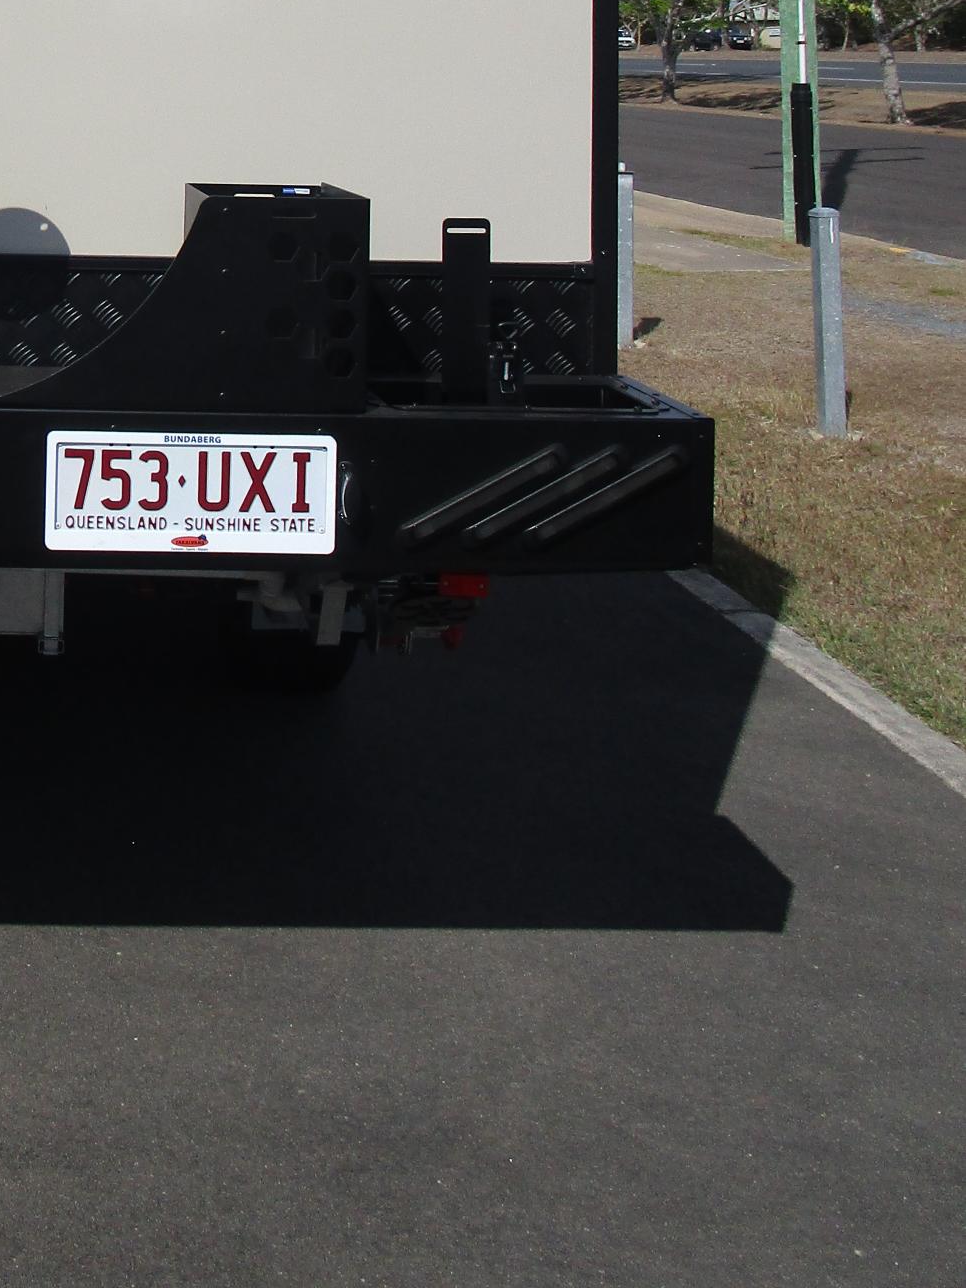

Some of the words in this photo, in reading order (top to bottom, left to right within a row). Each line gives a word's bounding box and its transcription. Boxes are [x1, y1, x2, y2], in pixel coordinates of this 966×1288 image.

[164, 435, 222, 444] BUNDABERG
[65, 515, 168, 530] QUEENSLAND
[184, 516, 261, 532] SUNSHINE
[270, 517, 316, 533] STATE
